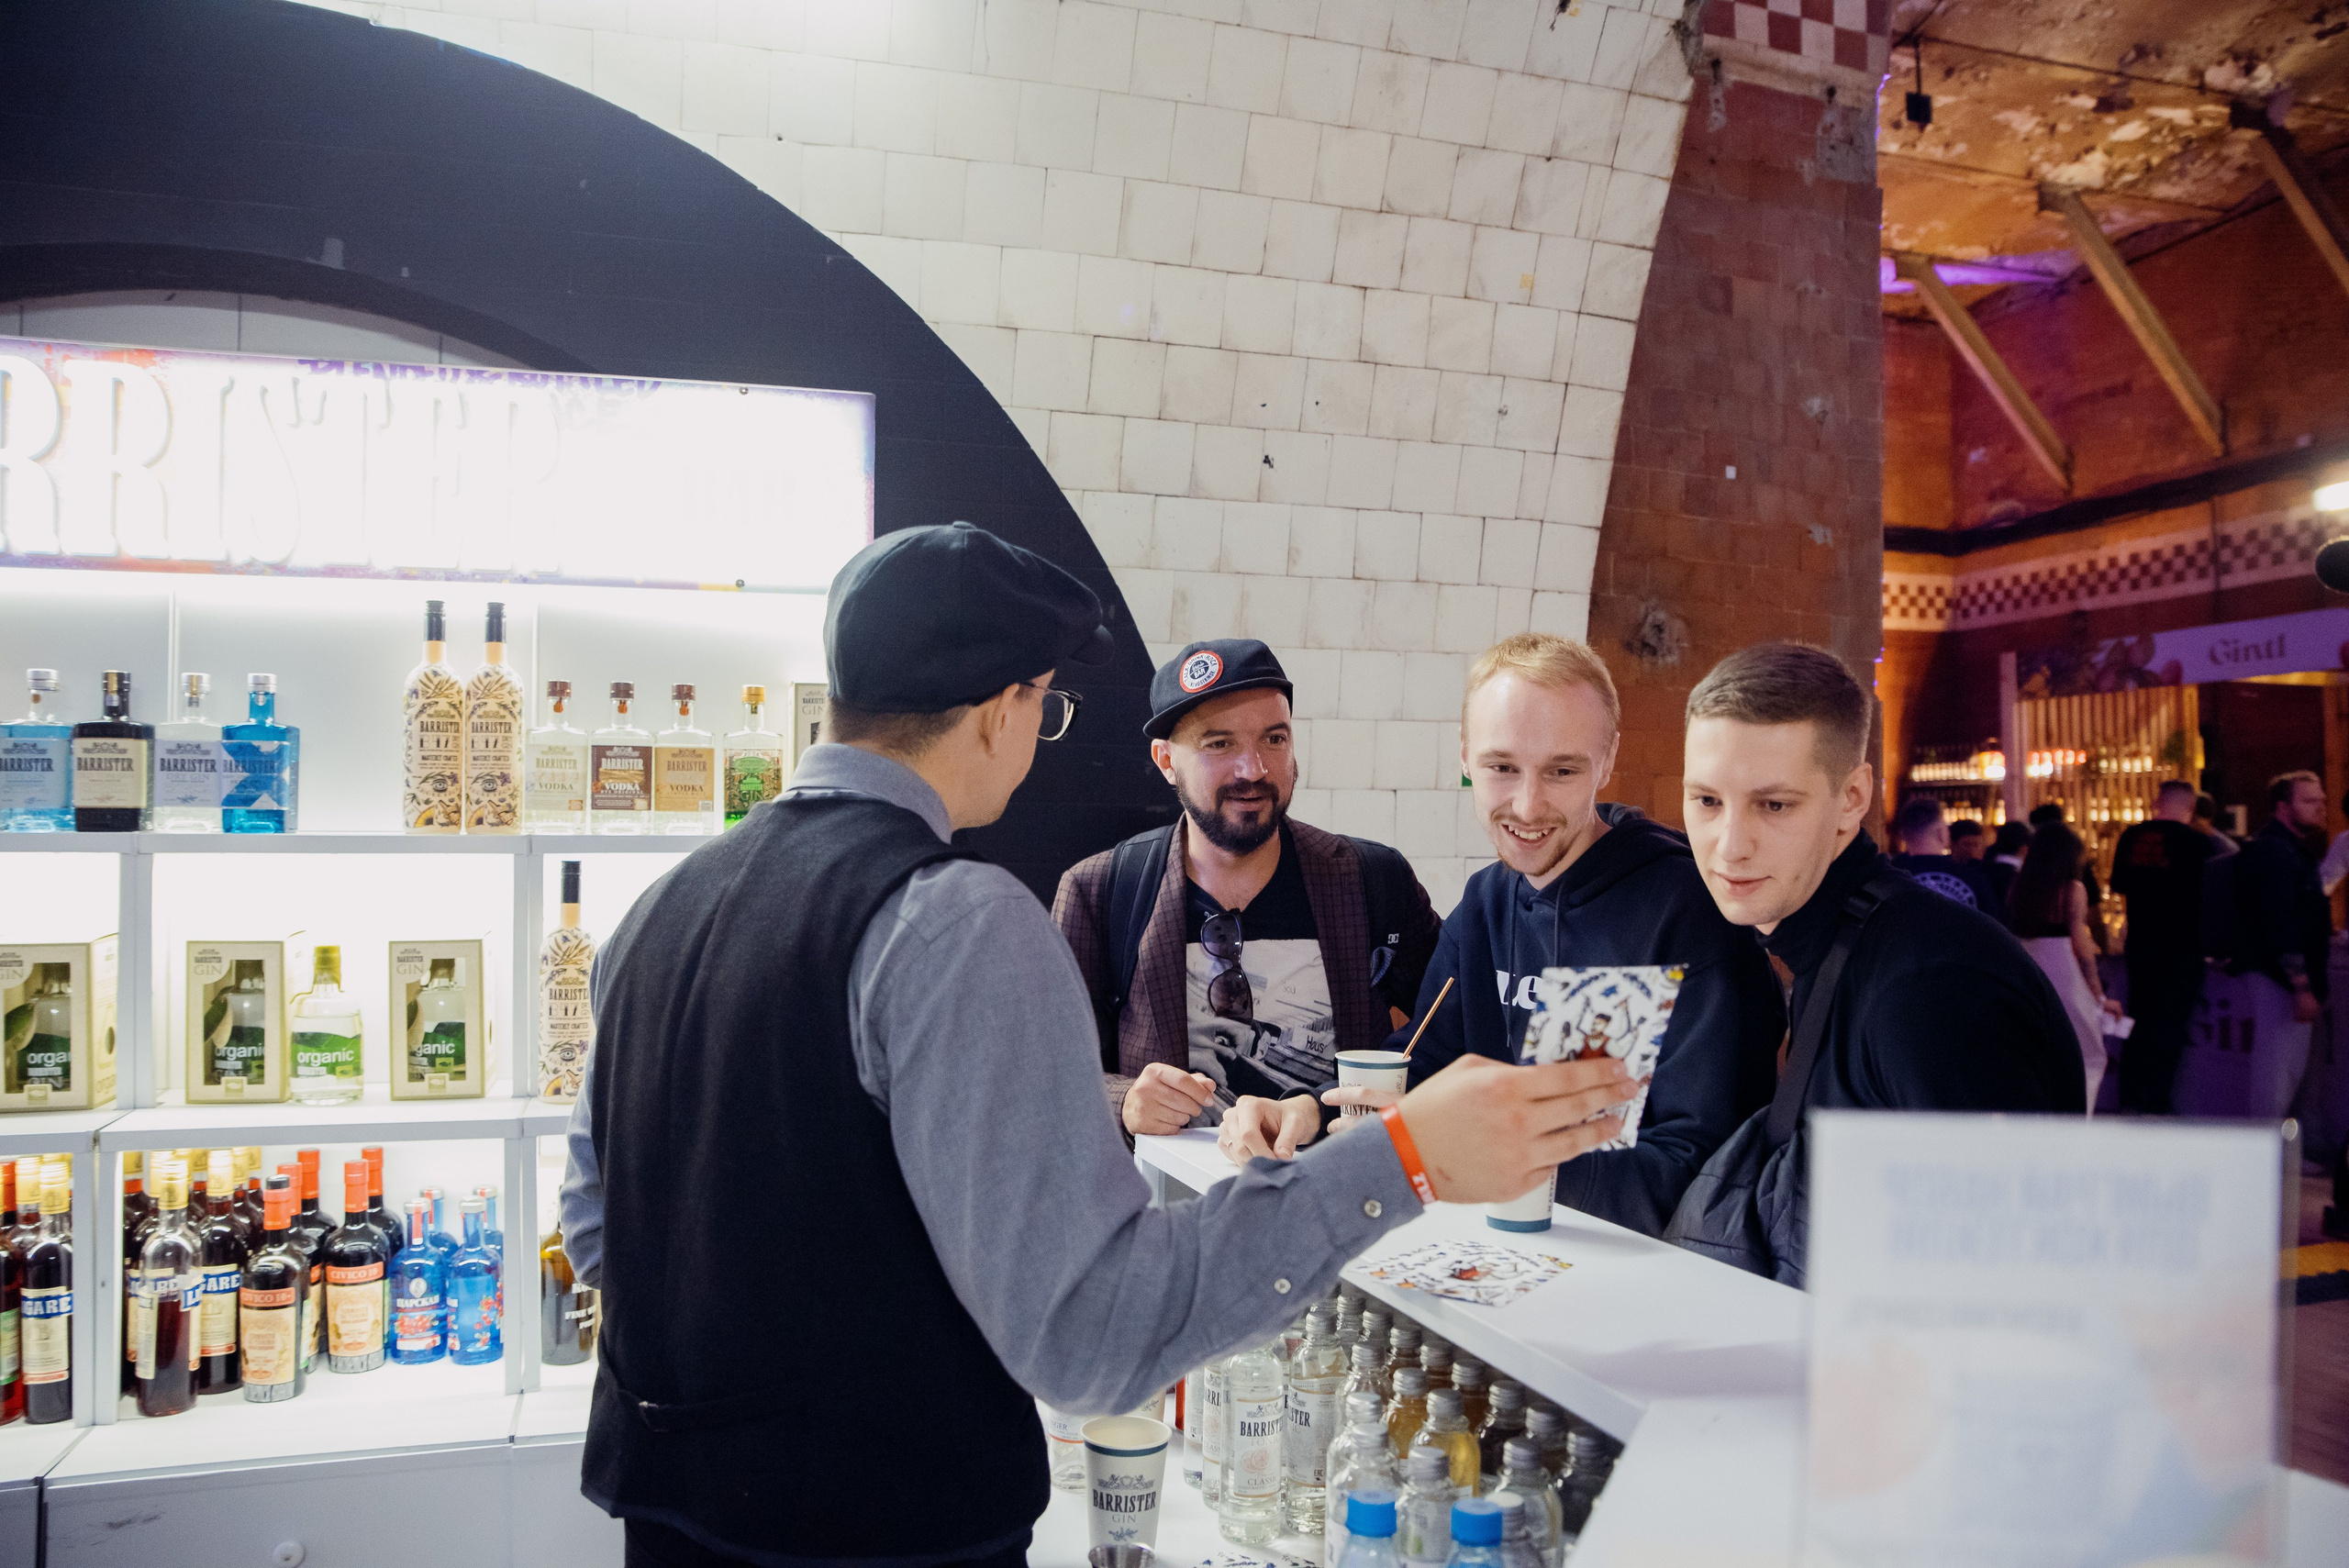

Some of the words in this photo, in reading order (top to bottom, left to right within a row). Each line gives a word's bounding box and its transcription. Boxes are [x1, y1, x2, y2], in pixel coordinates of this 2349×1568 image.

[472, 721, 513, 733] BARRISTER
[77, 757, 134, 772] BARRISTER
[160, 758, 217, 773] BARRISTER
[223, 759, 275, 773] BARRISTER
[536, 758, 577, 770] BARRISTER
[601, 758, 643, 770] BARRISTER
[667, 760, 707, 772] BARRISTER
[605, 783, 640, 791] VODKA
[194, 963, 223, 975] GIN
[395, 963, 424, 975] GIN
[296, 1048, 354, 1067] organic
[329, 1269, 367, 1281] CIVICO
[396, 1295, 440, 1308] ЦАРСКАЯ
[1092, 1488, 1157, 1514] BARRISTER
[1111, 1514, 1137, 1523] GIN
